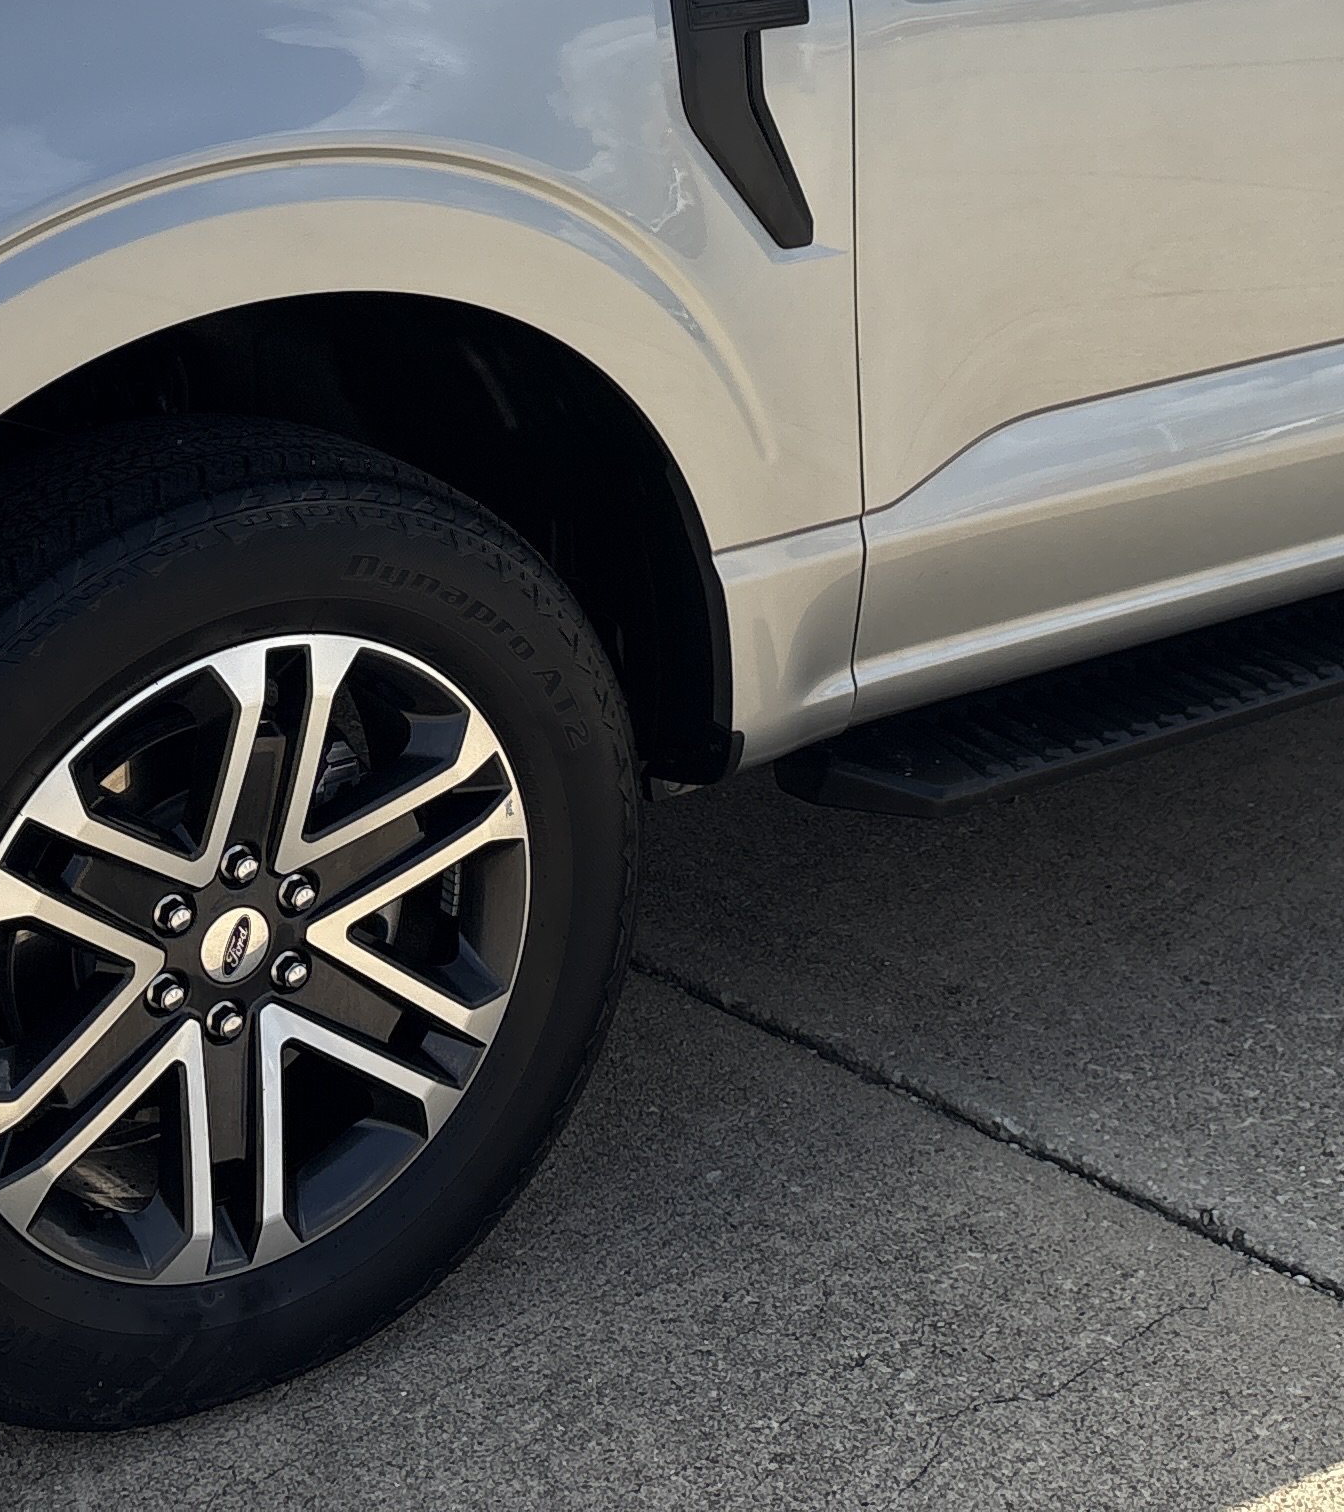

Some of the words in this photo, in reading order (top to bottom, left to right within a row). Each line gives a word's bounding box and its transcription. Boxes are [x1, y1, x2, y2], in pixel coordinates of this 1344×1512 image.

[342, 553, 536, 661] Dynapro
[532, 666, 591, 751] AT2
[225, 925, 249, 968] Ford
